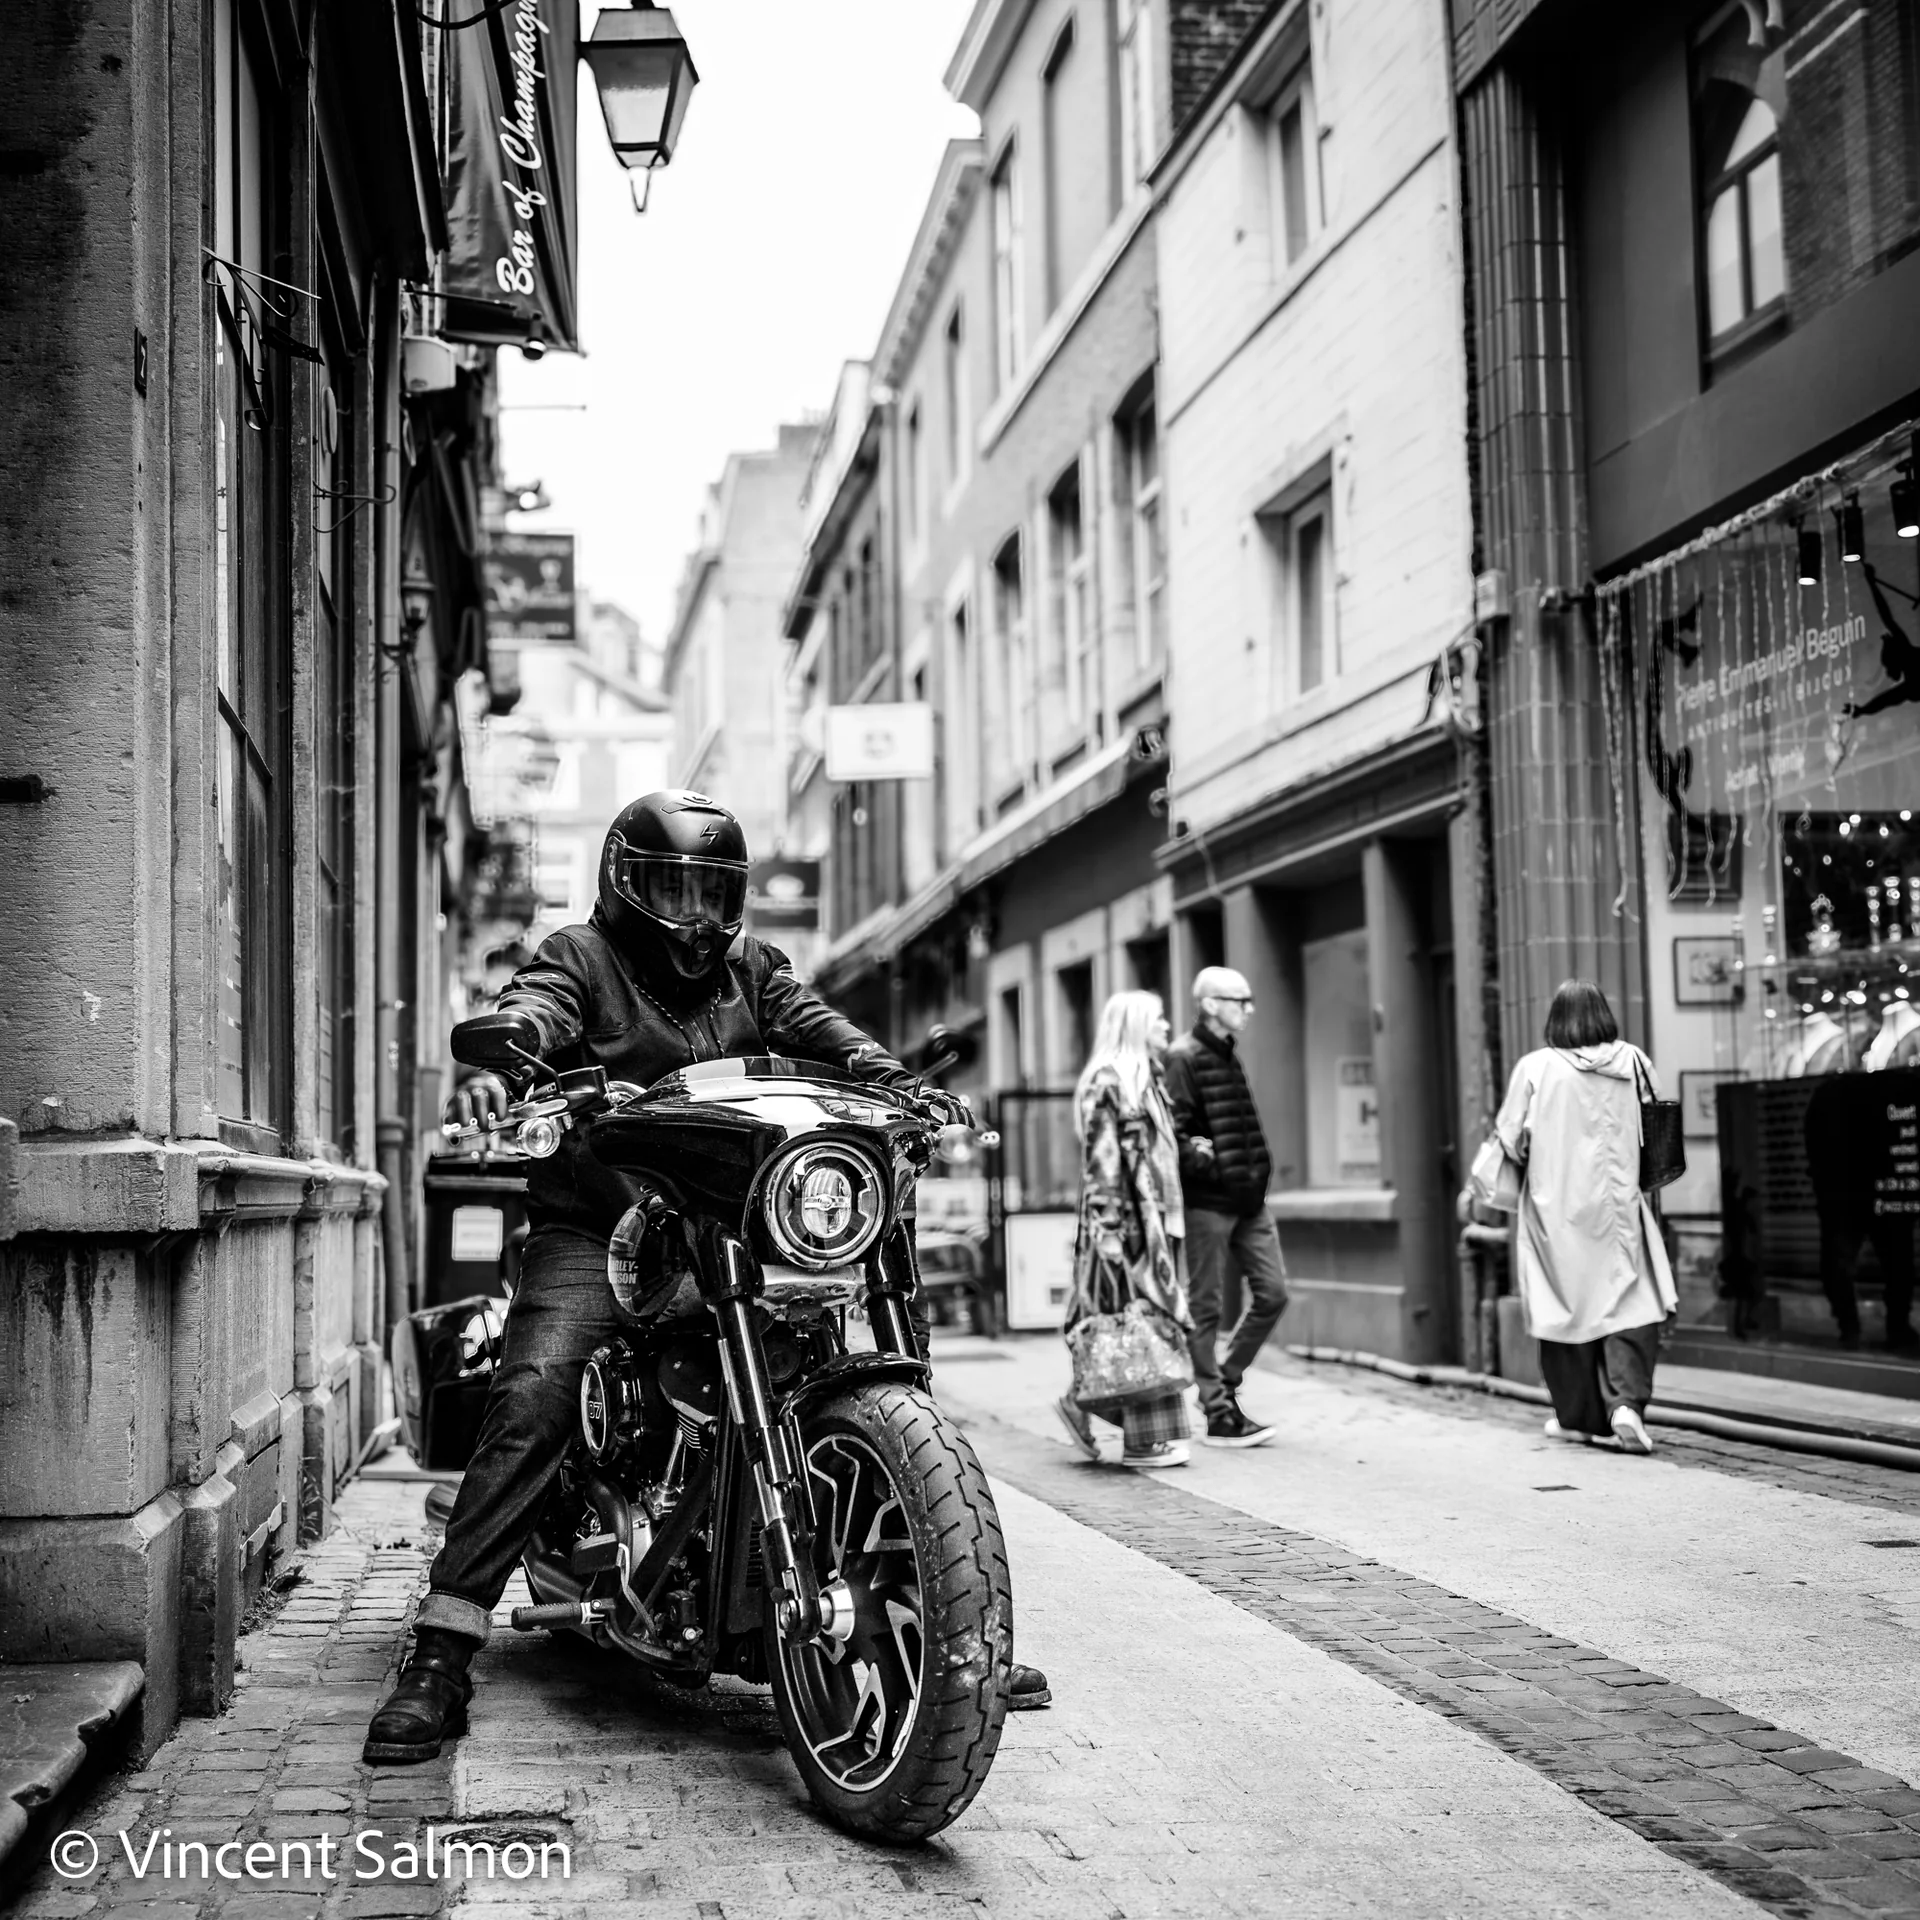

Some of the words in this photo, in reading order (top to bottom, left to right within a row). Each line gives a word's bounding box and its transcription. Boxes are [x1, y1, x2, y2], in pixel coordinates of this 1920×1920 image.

[502, 180, 548, 220] of
[496, 229, 535, 296] Bar
[1719, 634, 1803, 697] Emmanuel
